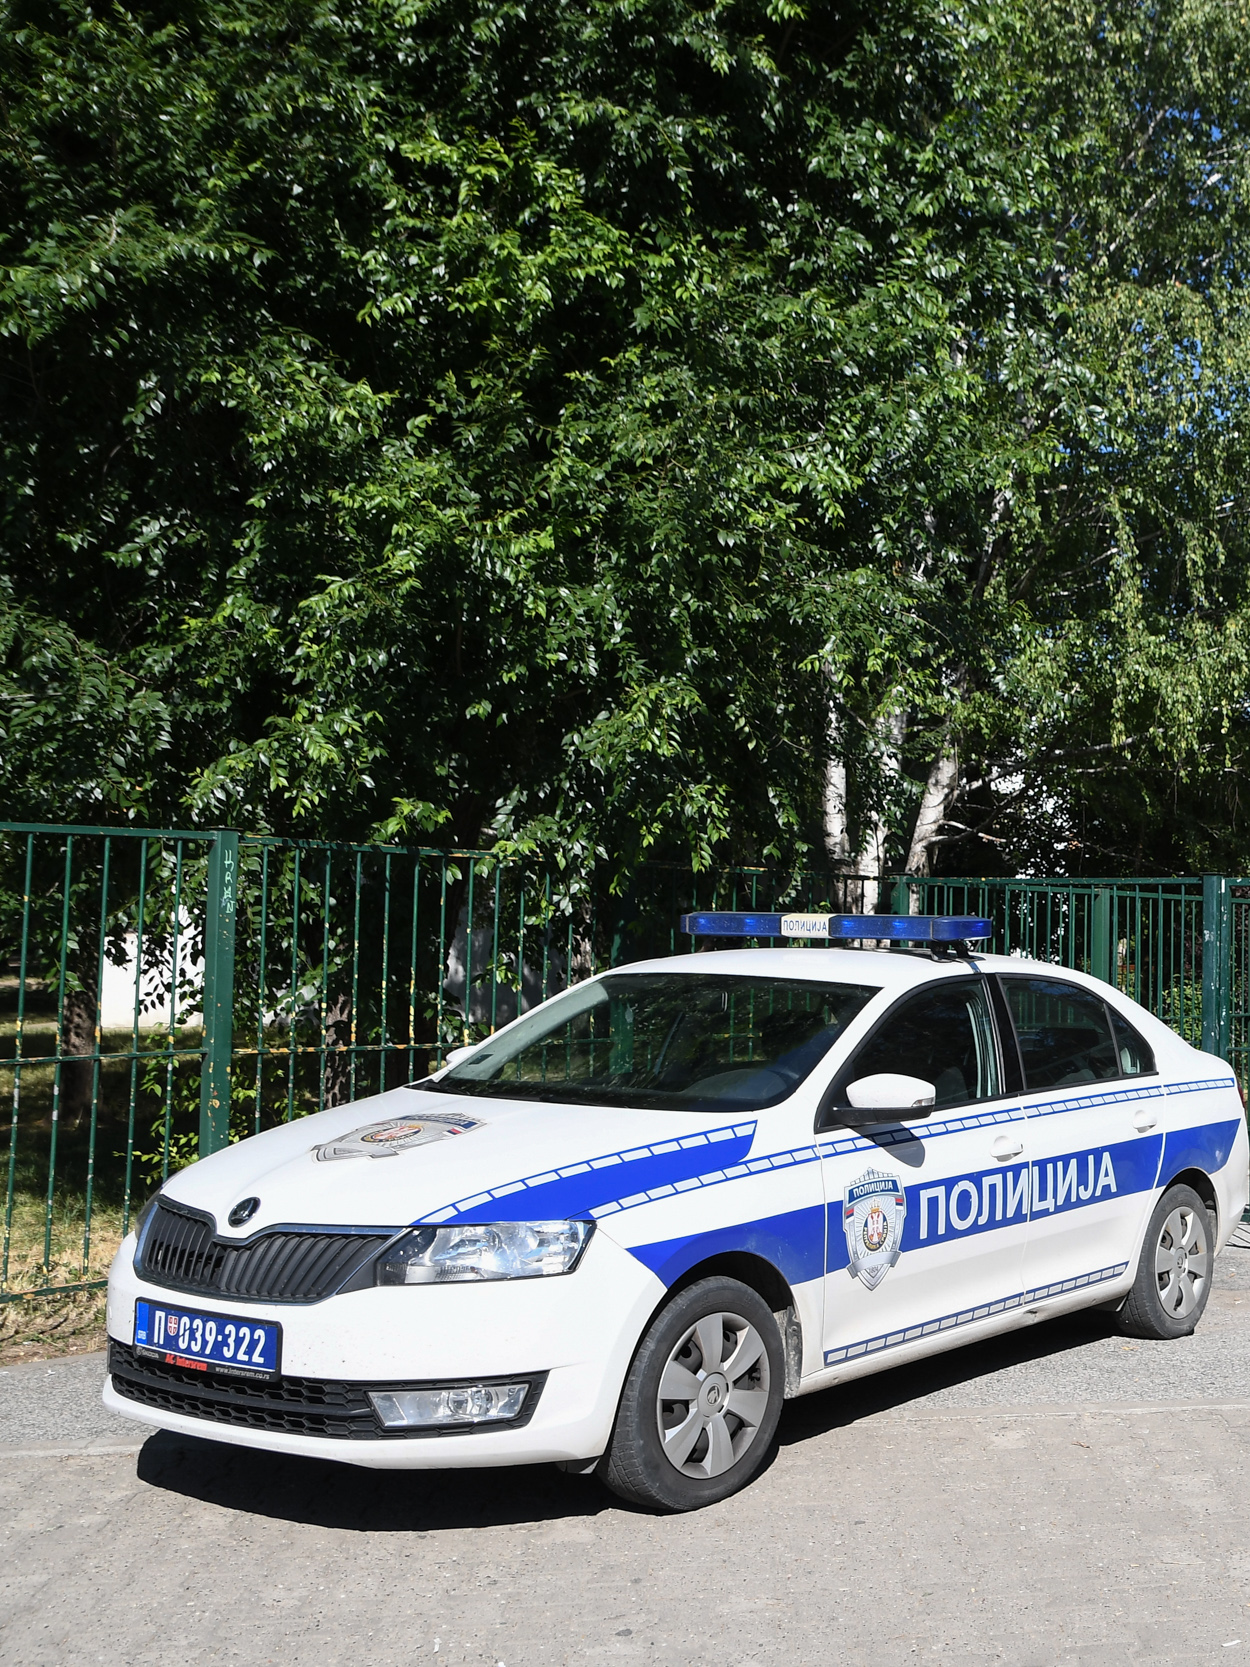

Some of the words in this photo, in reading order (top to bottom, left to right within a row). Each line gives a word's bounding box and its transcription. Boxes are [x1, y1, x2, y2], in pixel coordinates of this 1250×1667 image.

[783, 919, 828, 933] ПОЛИЦИЈА
[853, 1180, 894, 1198] ПОЛИЦИЈА
[919, 1151, 1118, 1240] ПОЛИЦИЈА
